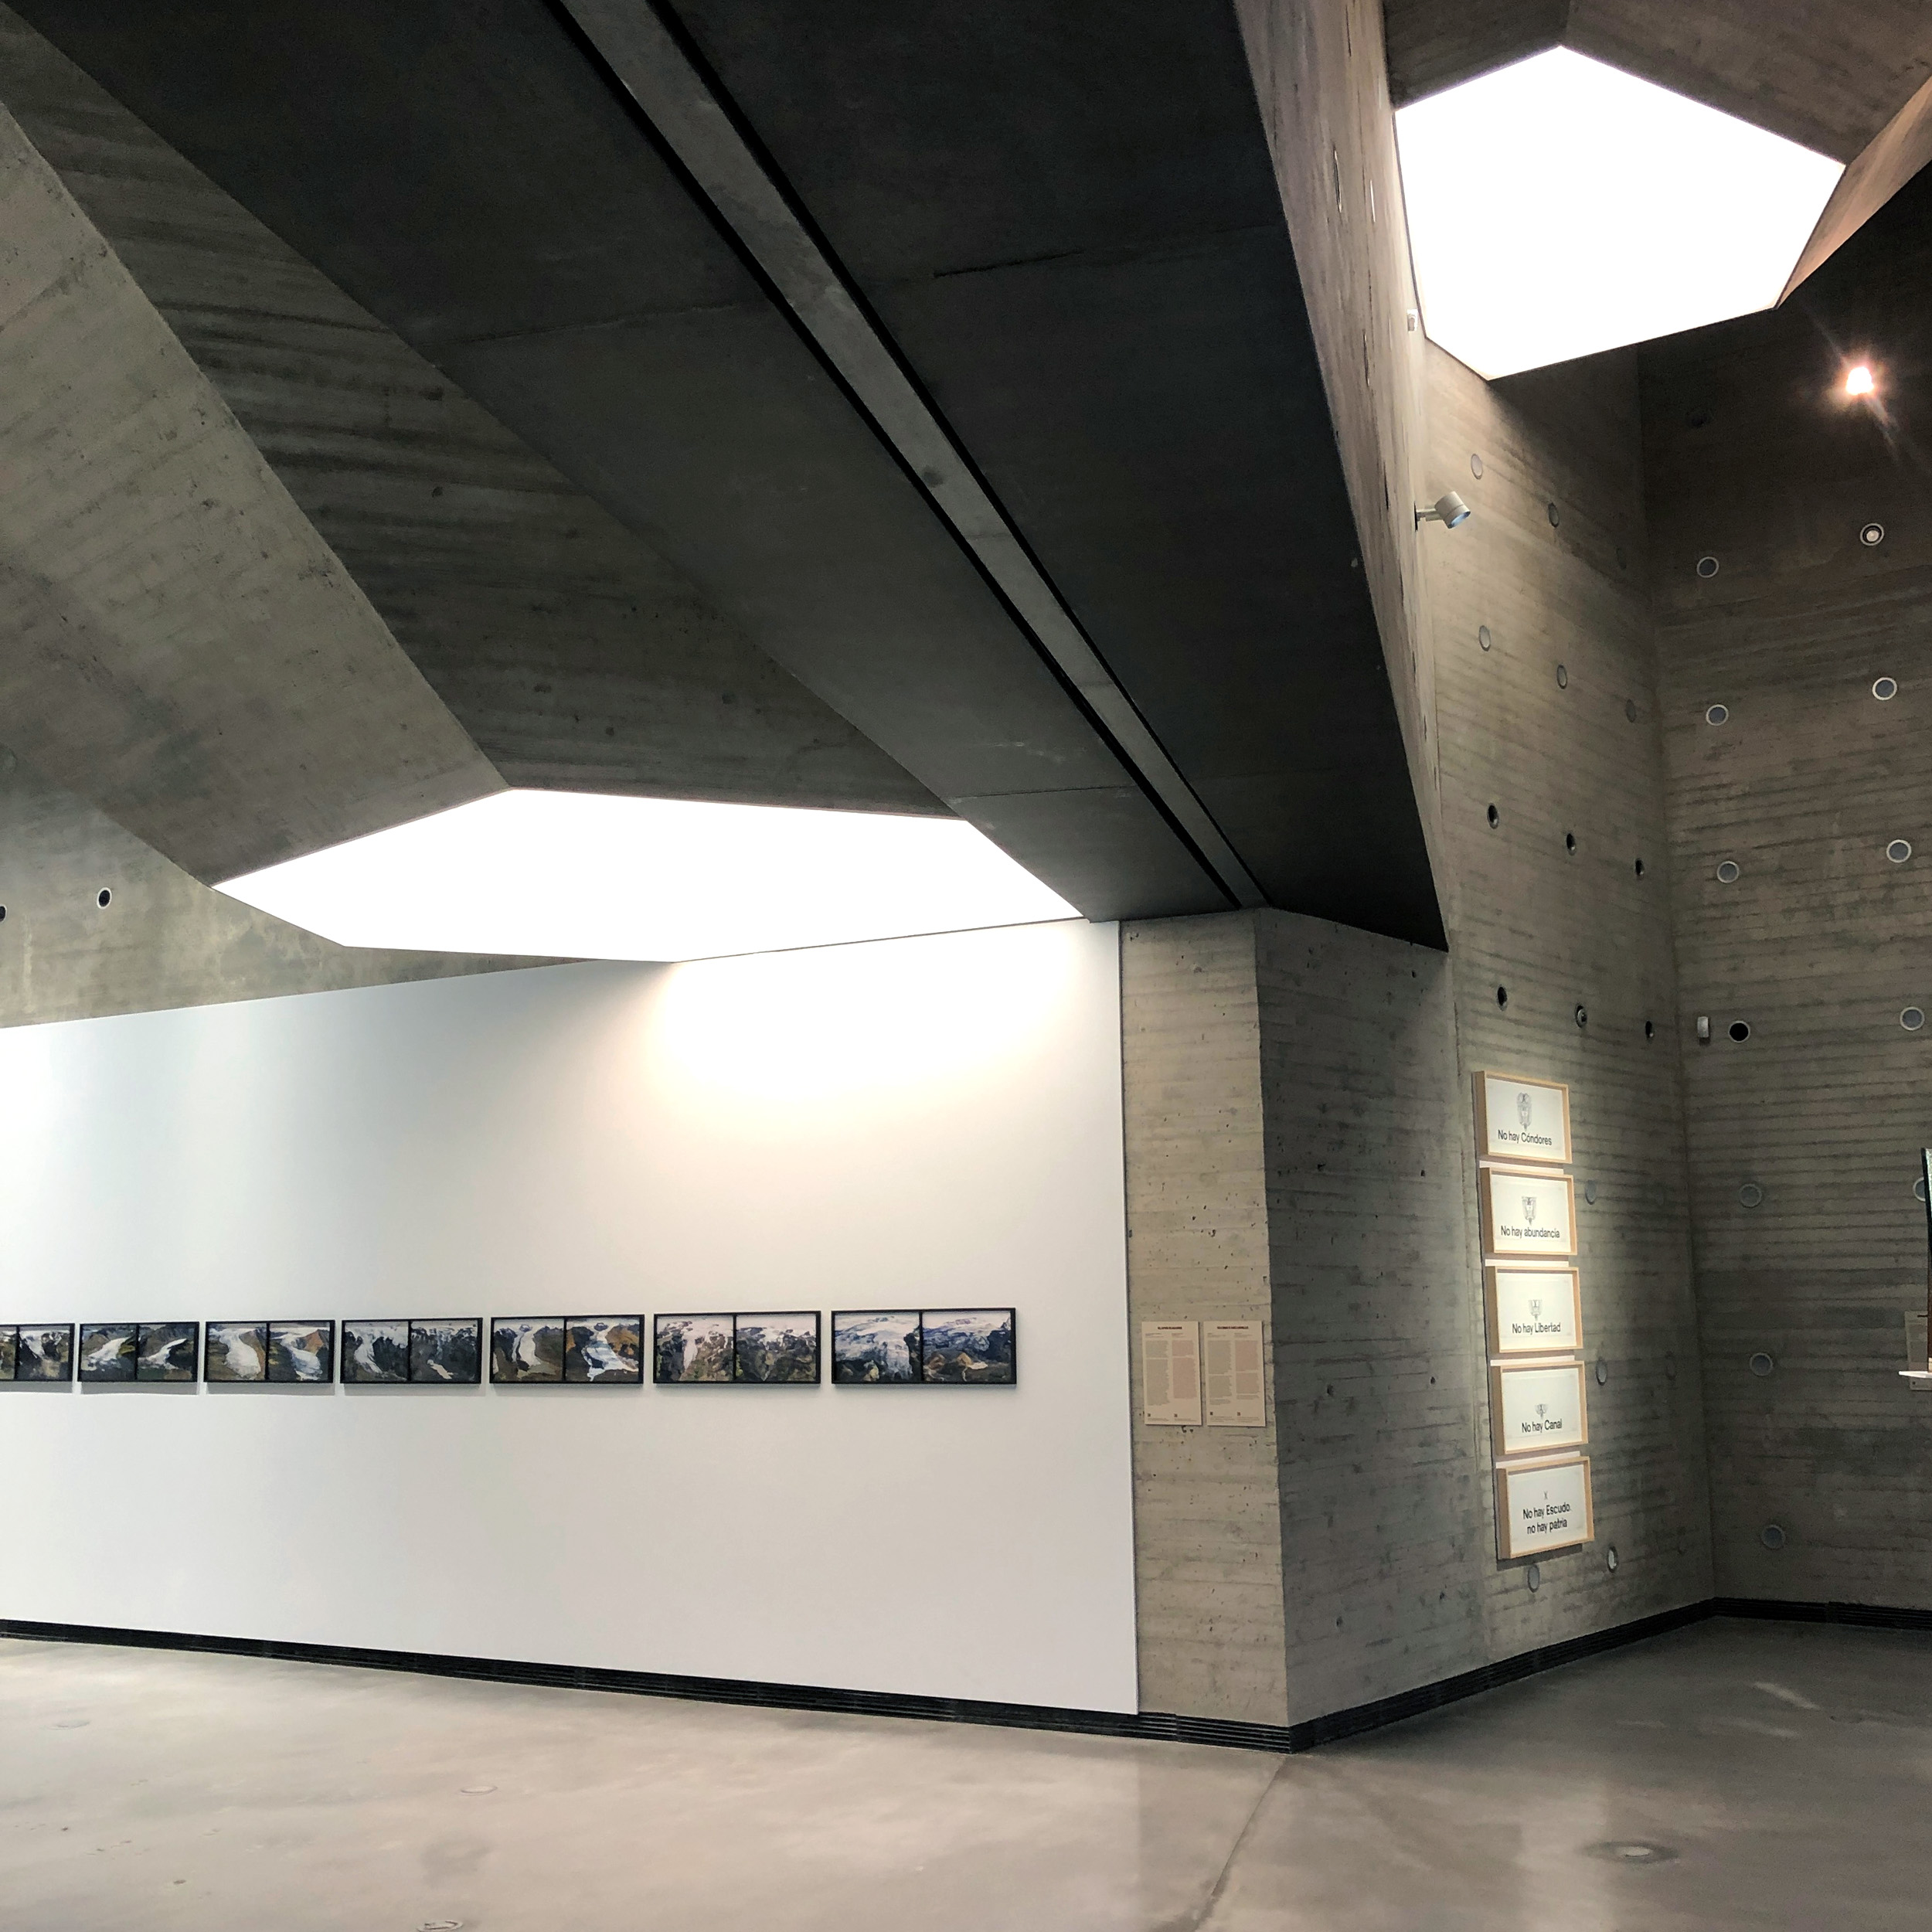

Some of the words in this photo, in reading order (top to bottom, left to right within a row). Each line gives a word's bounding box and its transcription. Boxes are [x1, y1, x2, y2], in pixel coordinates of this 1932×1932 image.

[1498, 1129, 1508, 1141] No
[1509, 1131, 1520, 1144] hay
[1501, 1225, 1510, 1236] No
[1512, 1226, 1522, 1239] hay
[1524, 1226, 1560, 1238] abundancia
[1512, 1323, 1522, 1334] No
[1522, 1323, 1533, 1335] hay
[1534, 1322, 1561, 1333] Libertad
[1522, 1422, 1531, 1433] No
[1532, 1421, 1543, 1434] hay
[1544, 1418, 1562, 1430] Canal
[1522, 1509, 1532, 1519] No
[1533, 1507, 1545, 1519] hay
[1527, 1525, 1536, 1534] no
[1536, 1522, 1548, 1534] hay
[1549, 1518, 1567, 1532] patria
